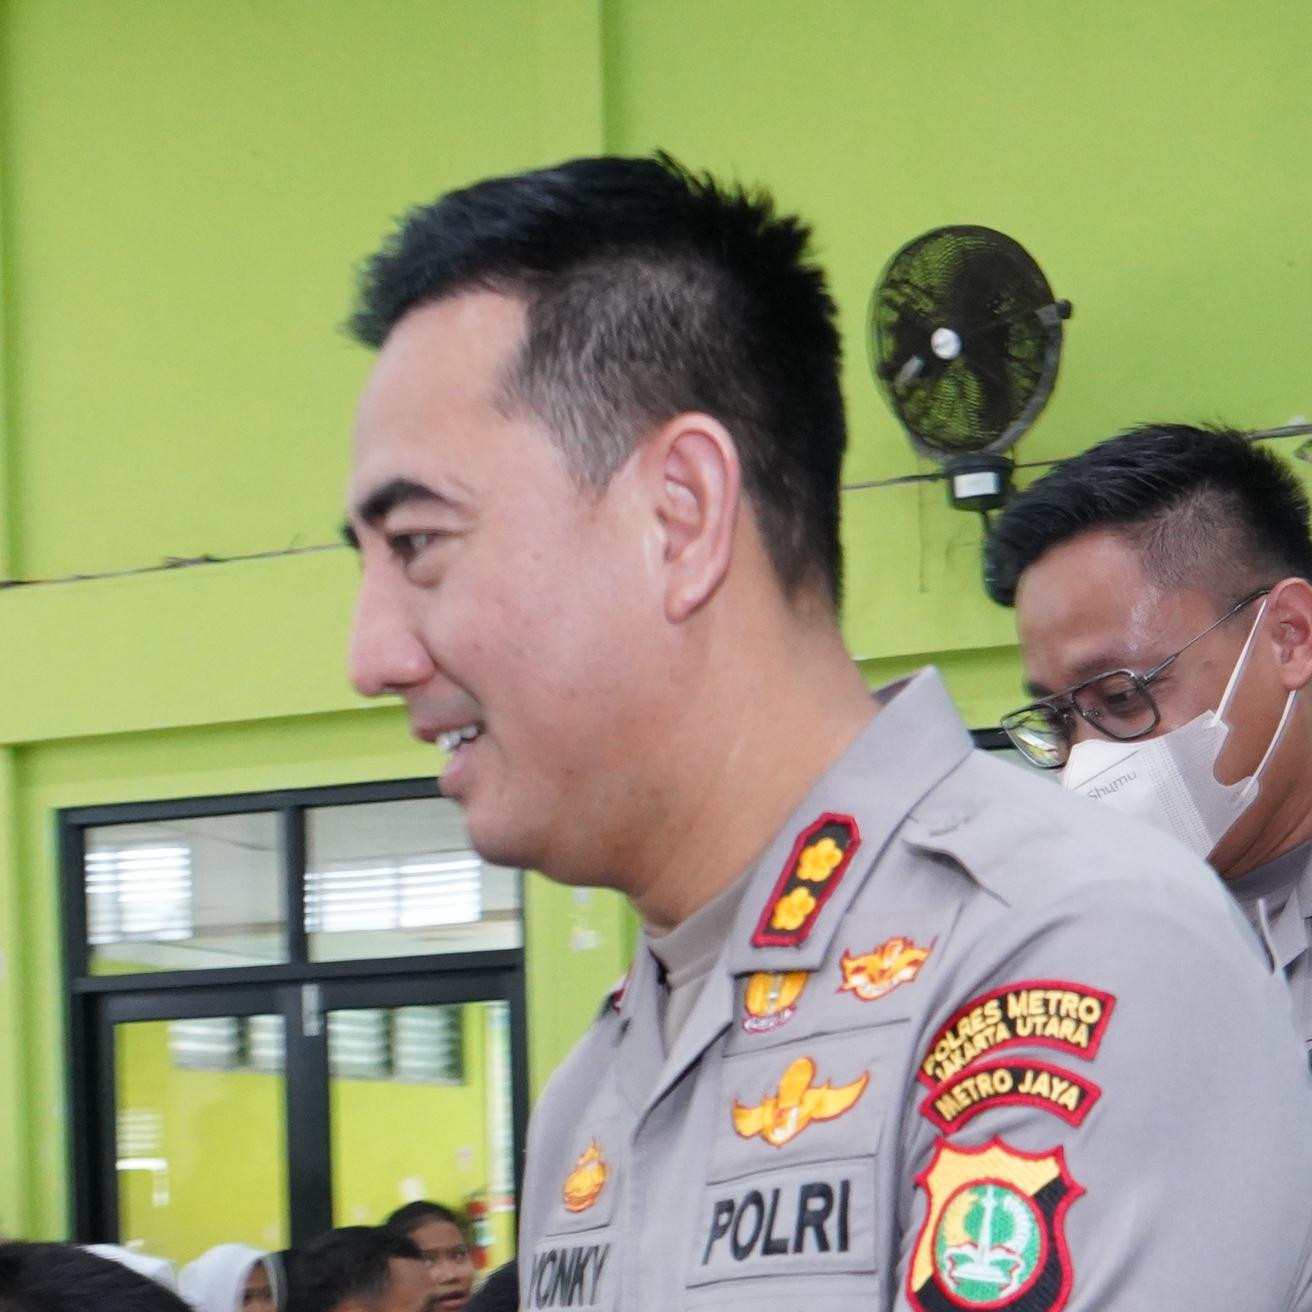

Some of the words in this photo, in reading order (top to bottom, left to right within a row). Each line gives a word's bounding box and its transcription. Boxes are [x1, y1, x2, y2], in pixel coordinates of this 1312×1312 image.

[923, 999, 1002, 1076] POLRES
[1007, 989, 1101, 1024] METRO
[935, 1022, 1012, 1081] JAKARTA
[1016, 1015, 1089, 1048] UTARA
[935, 1068, 1013, 1121] METRO
[1018, 1069, 1081, 1111] JAYA
[701, 1179, 850, 1266] POLRI
[527, 1243, 611, 1311] YONKY
